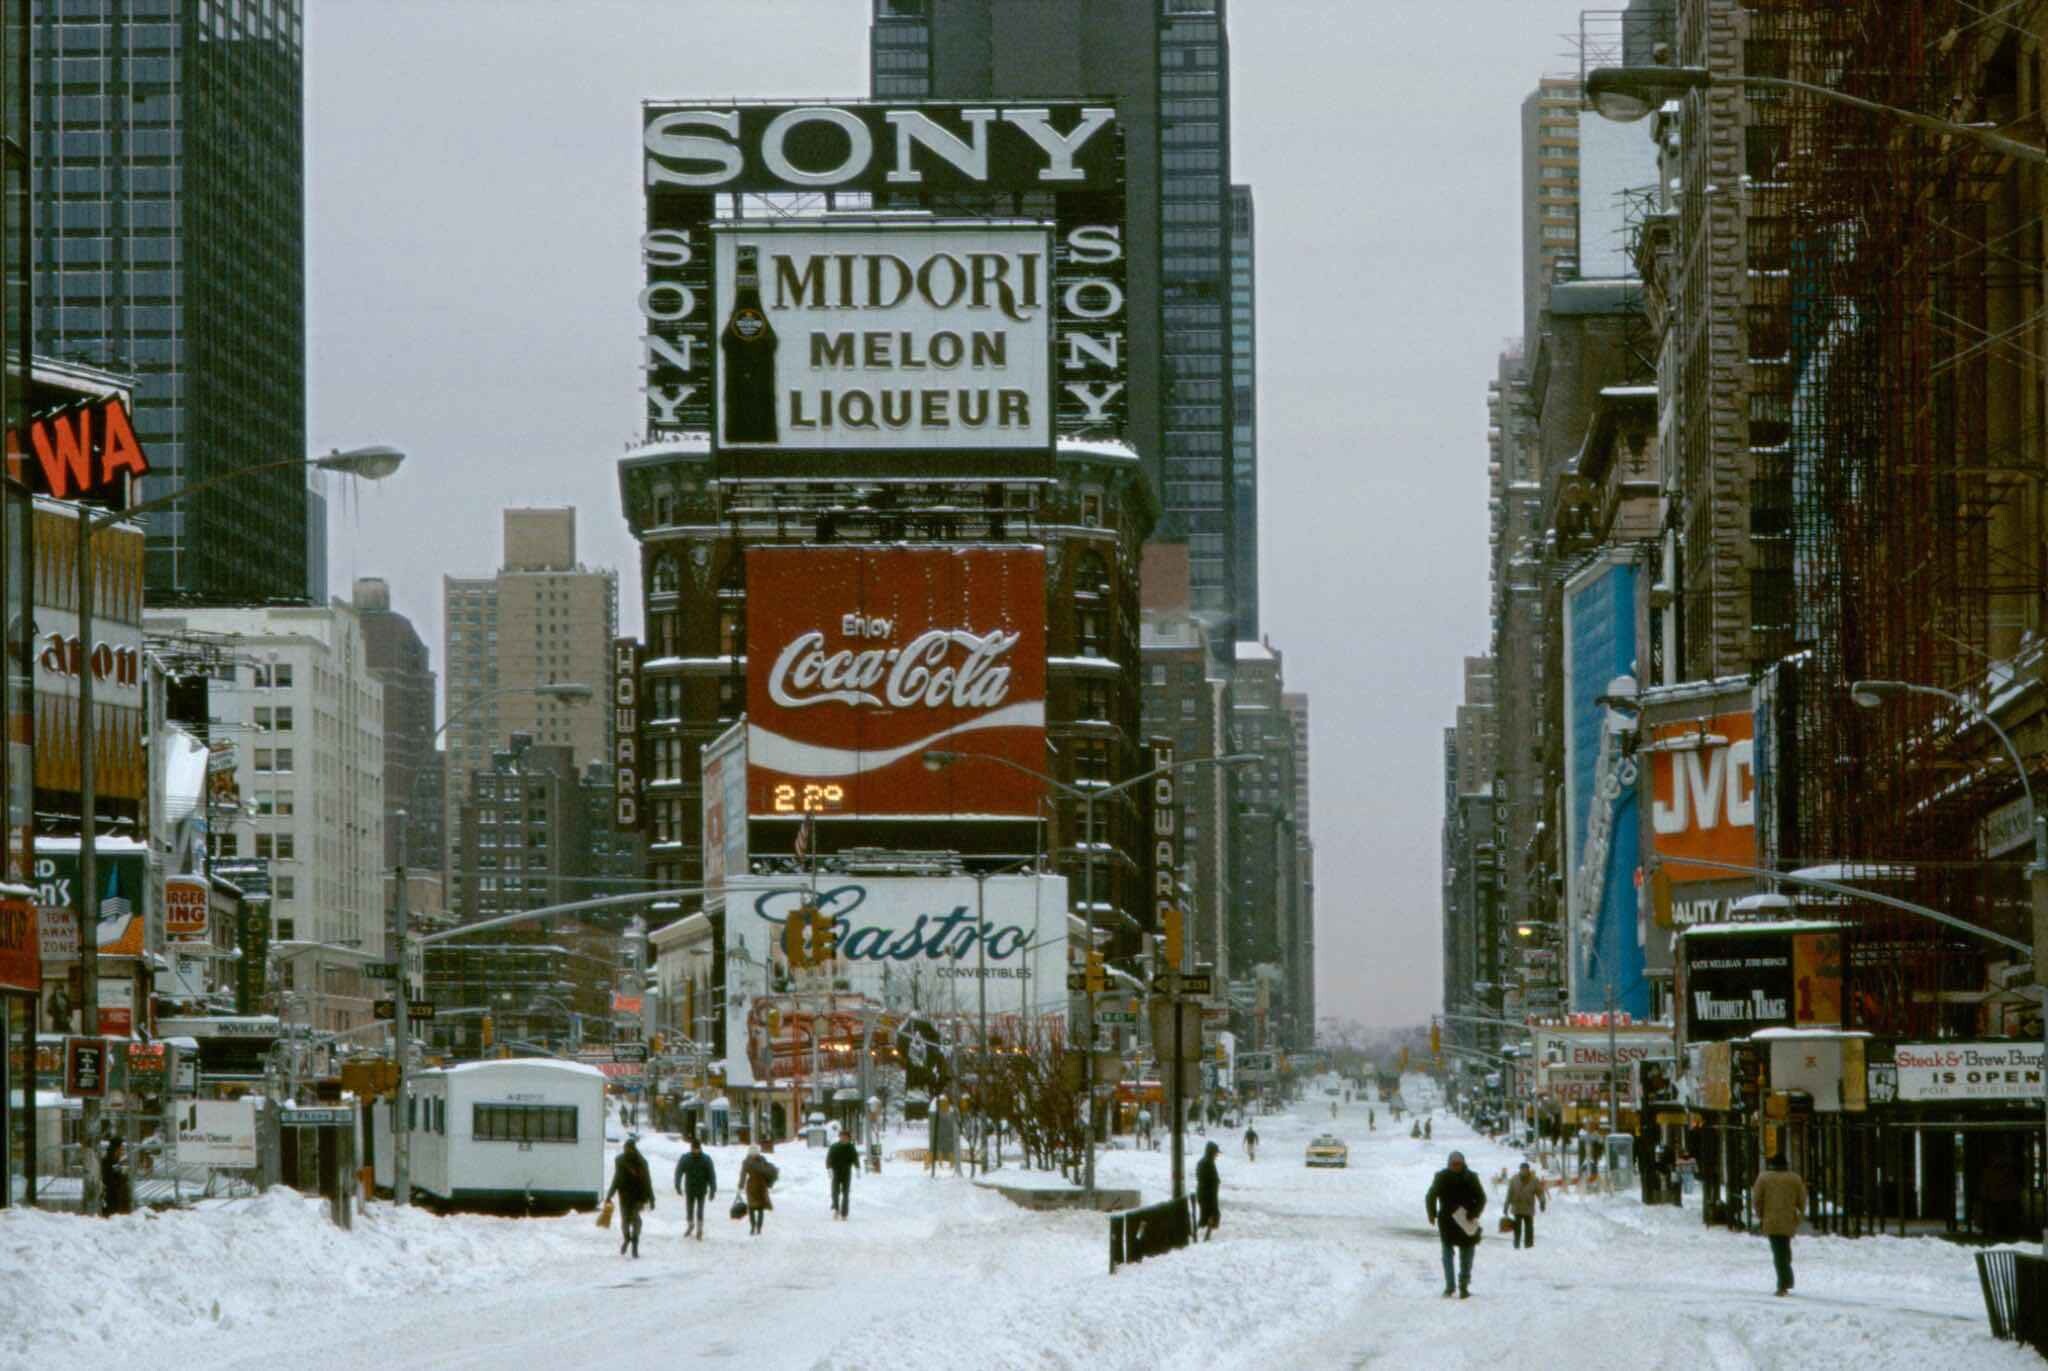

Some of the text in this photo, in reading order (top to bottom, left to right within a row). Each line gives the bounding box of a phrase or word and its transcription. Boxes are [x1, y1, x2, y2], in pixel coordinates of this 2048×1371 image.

[644, 107, 1116, 186] SONY
[770, 252, 1042, 321] MIDORI
[639, 228, 697, 424] SONY
[1064, 224, 1124, 422] SONY
[809, 331, 1008, 369] MELON
[788, 389, 1031, 431] LIQUEUR
[841, 614, 895, 640] Enjoy
[768, 629, 1021, 708] Coca-Cola
[615, 647, 636, 825] HOWARD
[1652, 738, 1755, 834] JVC
[40, 927, 74, 938] AWAY
[168, 906, 205, 922] ING
[754, 884, 1037, 961] Castro
[43, 942, 75, 953] ZONE
[936, 967, 1033, 979] CONVERTIBLES
[1574, 1047, 1648, 1064] EMBSSY
[1932, 1071, 2041, 1084] IS OPEN
